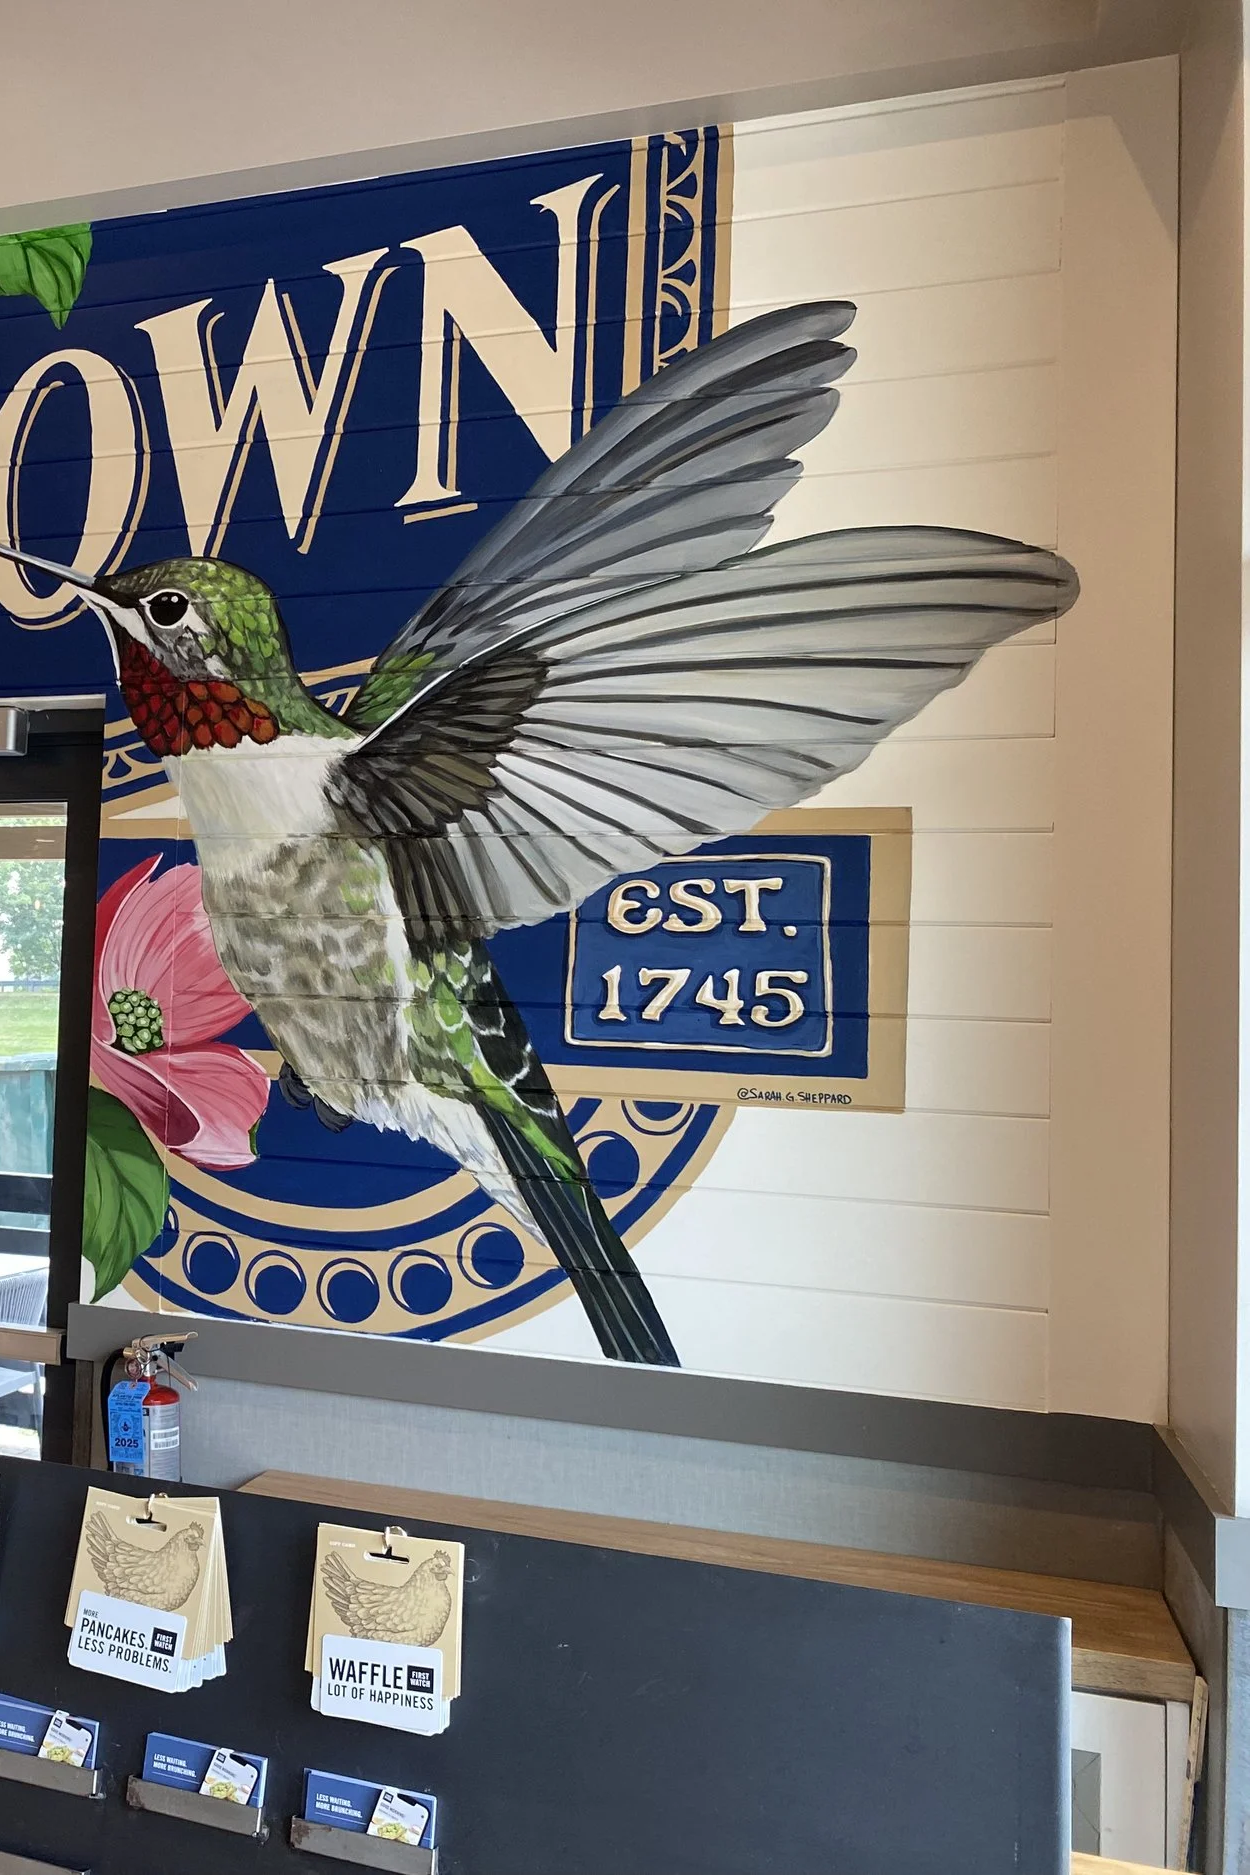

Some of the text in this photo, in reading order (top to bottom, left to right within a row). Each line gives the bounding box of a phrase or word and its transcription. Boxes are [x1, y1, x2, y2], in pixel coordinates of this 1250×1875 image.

[607, 877, 798, 938] EST.
[598, 964, 809, 1028] 1745
[115, 1438, 139, 1449] 2025
[83, 1608, 99, 1619] MORE
[80, 1617, 148, 1650] PANCAKES.
[156, 1633, 173, 1643] FIRST
[154, 1640, 173, 1651] WATCH
[78, 1635, 172, 1674] LESS PROBLEMS.
[329, 1656, 403, 1690] WAFFLE
[411, 1670, 430, 1681] FIRST
[410, 1678, 431, 1688] WATCH
[327, 1683, 434, 1711] LOT OF HAPPINESS
[154, 1753, 165, 1762] LESS
[153, 1761, 197, 1778] MORE BRUNCHING.
[316, 1793, 329, 1802] LESS
[315, 1801, 363, 1818] MORE BRUNCHING.
